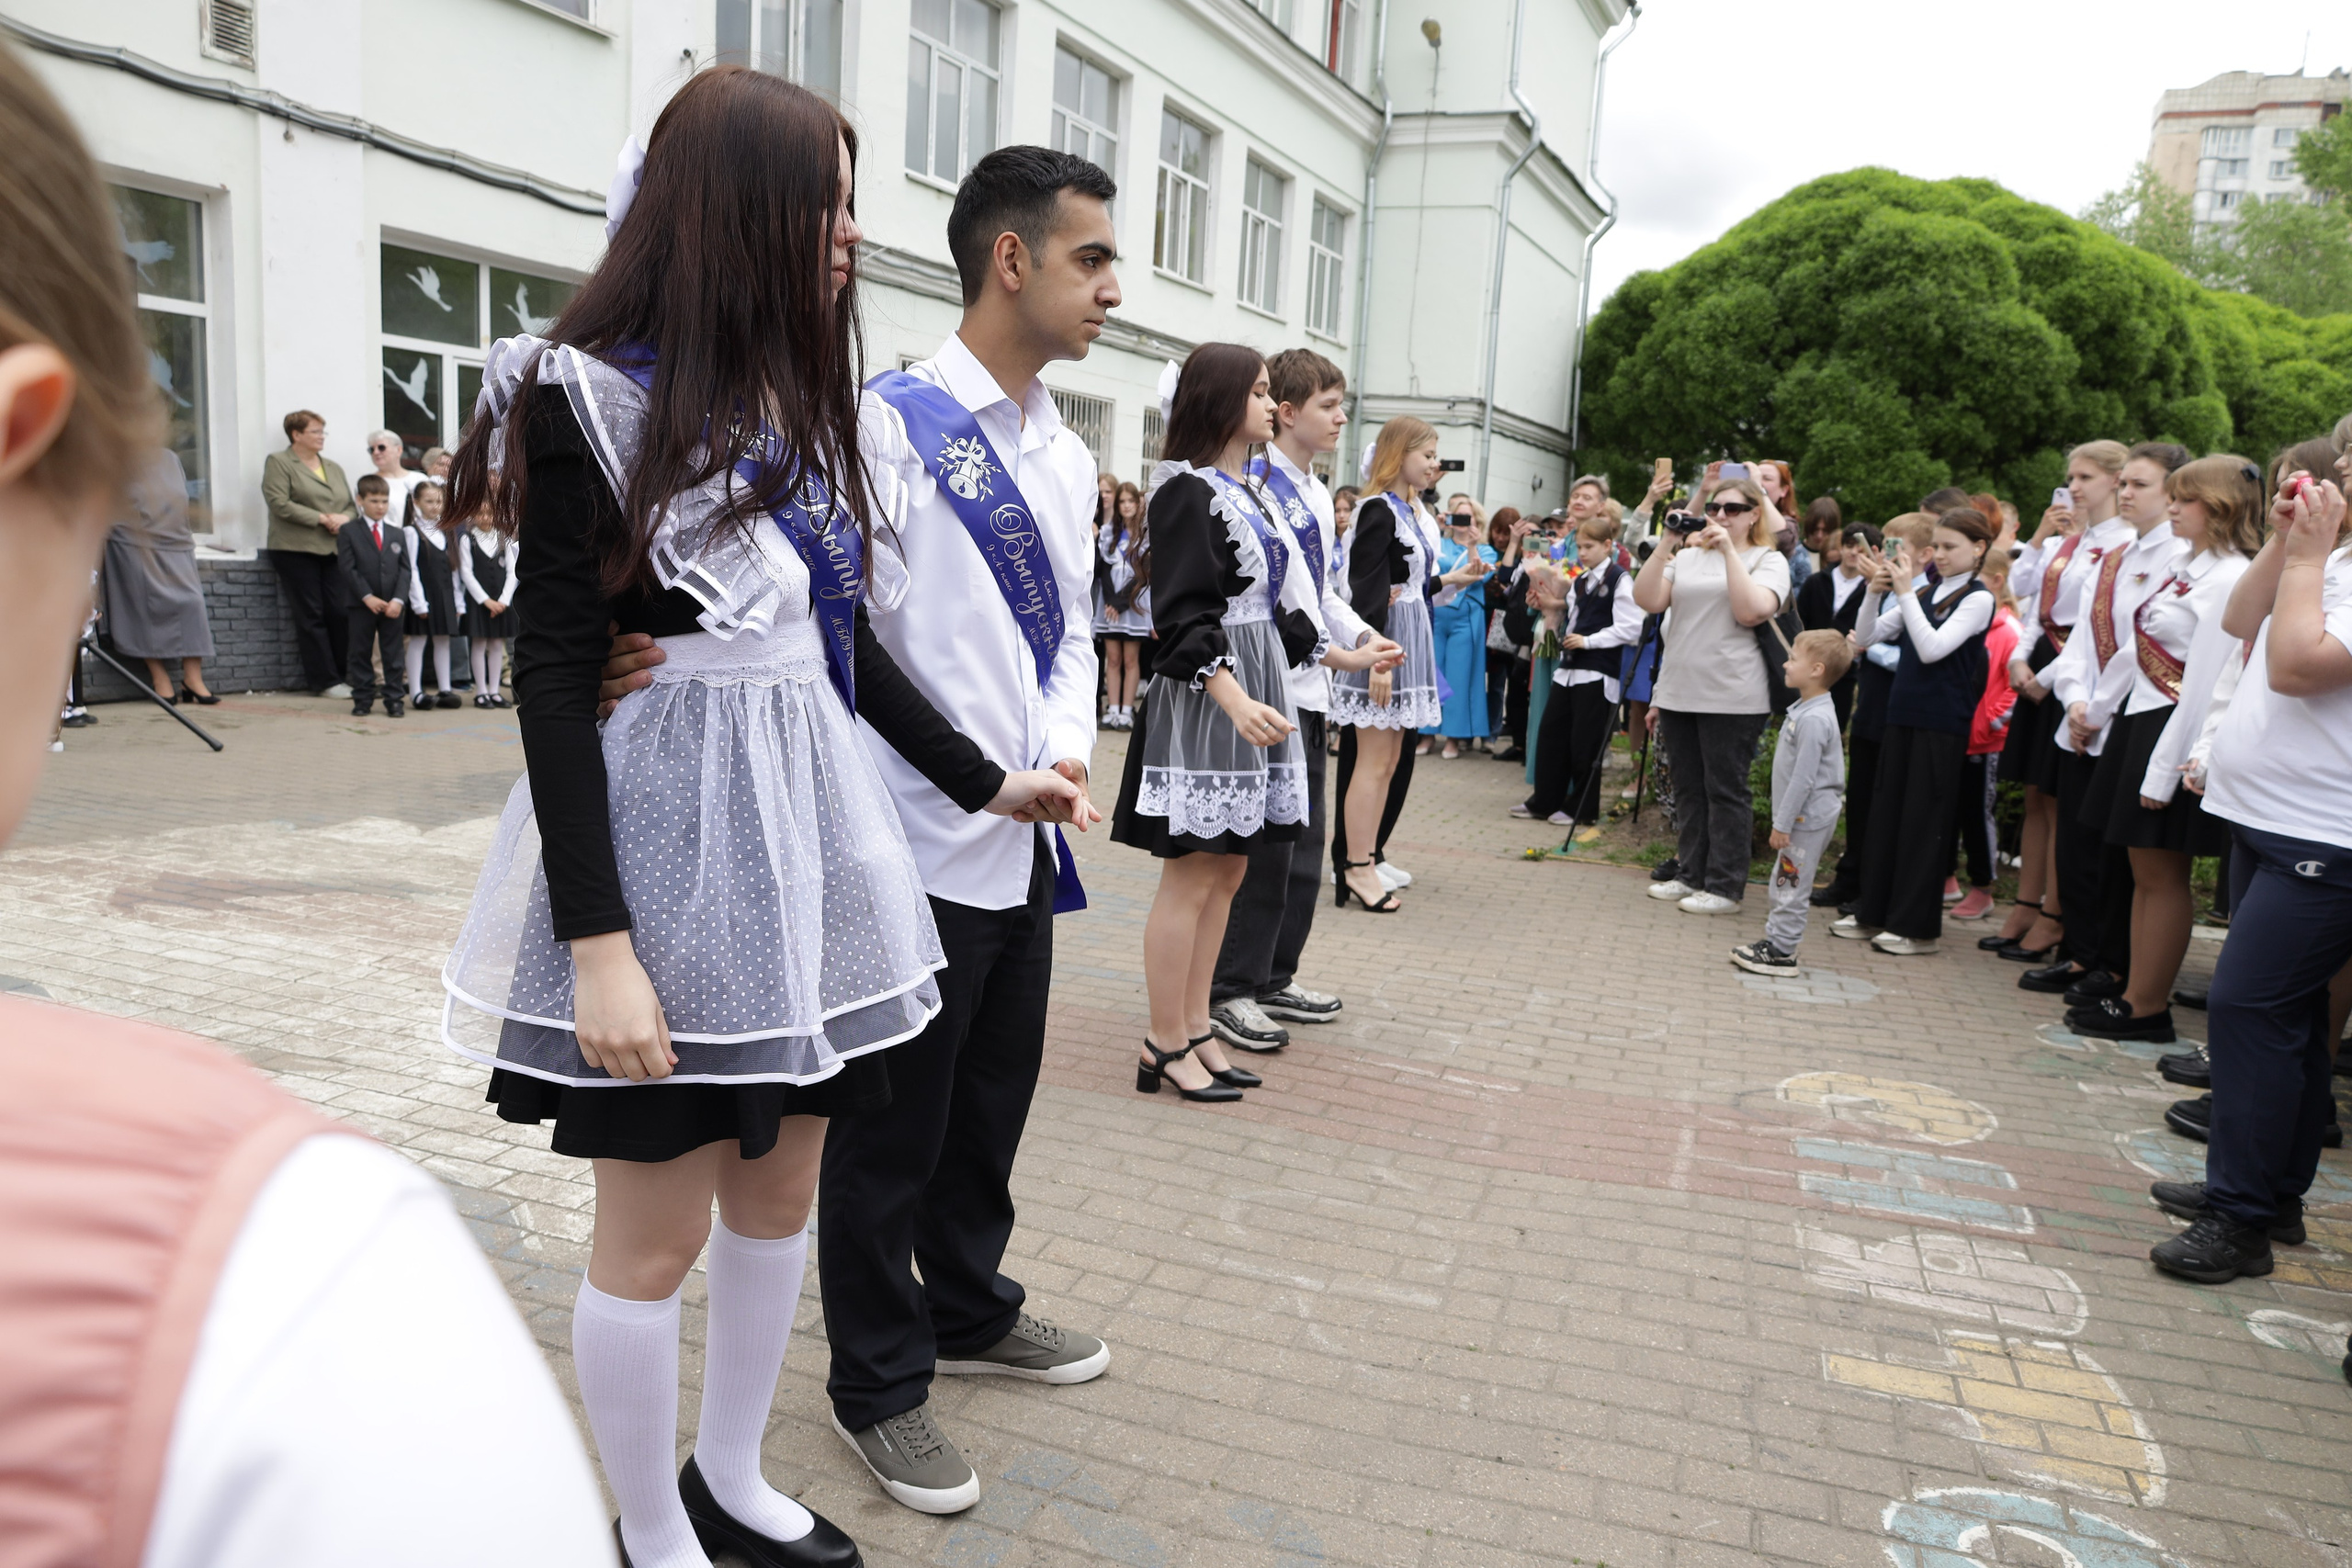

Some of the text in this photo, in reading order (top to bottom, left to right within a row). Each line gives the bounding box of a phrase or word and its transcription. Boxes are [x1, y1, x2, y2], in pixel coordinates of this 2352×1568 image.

[783, 511, 793, 519] 9
[789, 470, 859, 601] Выпу
[989, 503, 1057, 661] Выпускни
[830, 615, 852, 650] МБОУ
